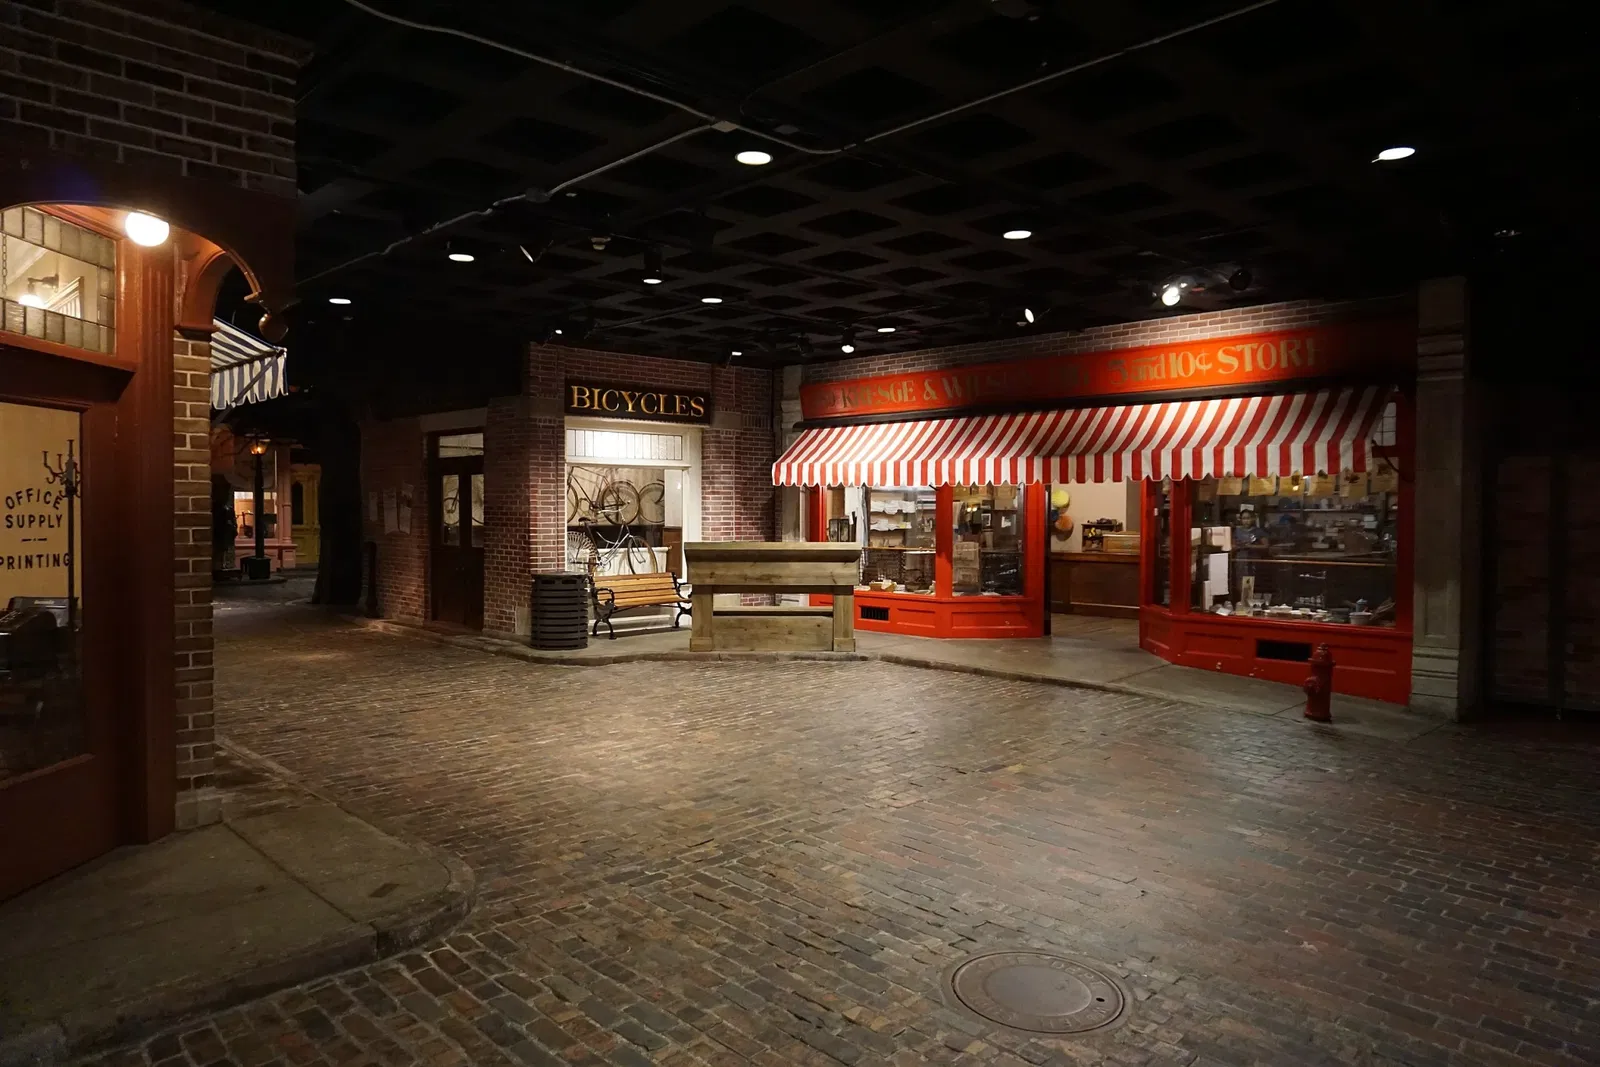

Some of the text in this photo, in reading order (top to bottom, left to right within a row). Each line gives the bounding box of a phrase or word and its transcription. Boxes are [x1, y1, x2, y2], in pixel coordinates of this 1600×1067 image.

[923, 378, 939, 401] &
[1107, 357, 1129, 386] 5
[570, 385, 705, 417] BICYCLES
[5, 488, 63, 510] OFFICE
[5, 514, 63, 529] SUPPLY
